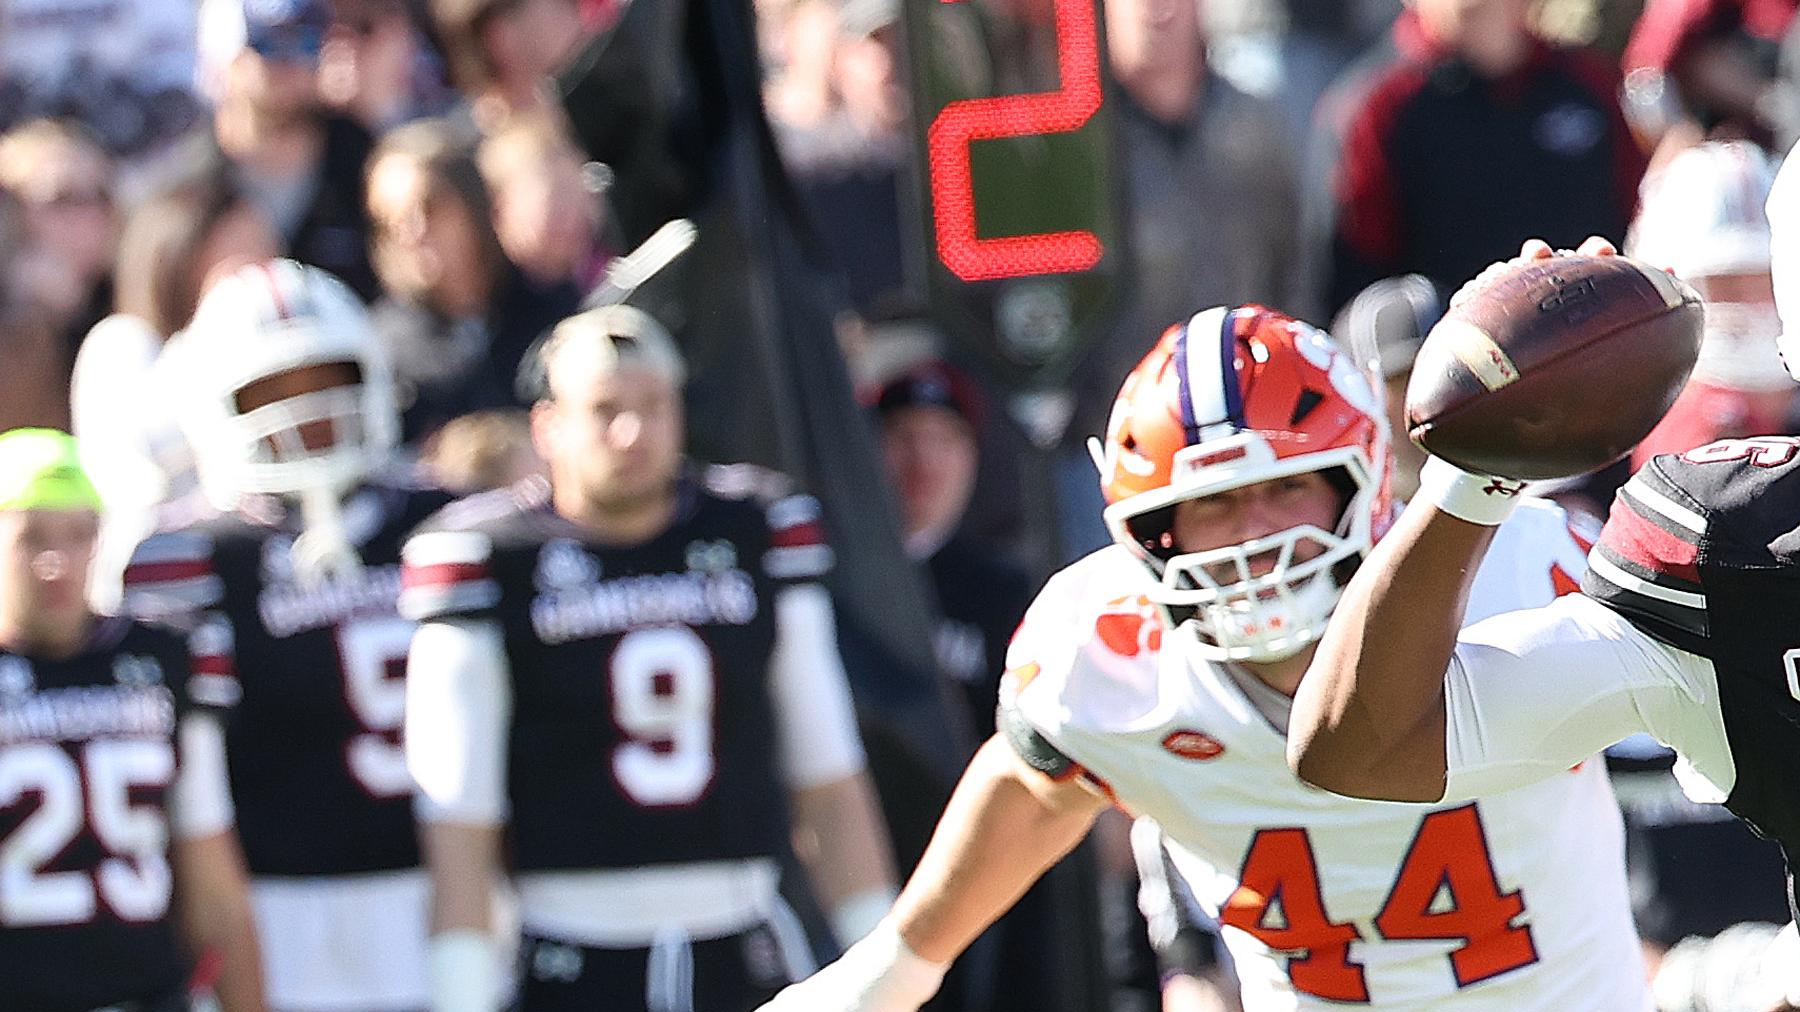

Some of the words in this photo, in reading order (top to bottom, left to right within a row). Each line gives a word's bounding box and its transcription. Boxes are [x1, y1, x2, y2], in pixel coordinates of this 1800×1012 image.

[927, 0, 1104, 281] 2
[607, 624, 717, 809] 9
[0, 740, 178, 929] 25
[1219, 801, 1539, 1005] 44
